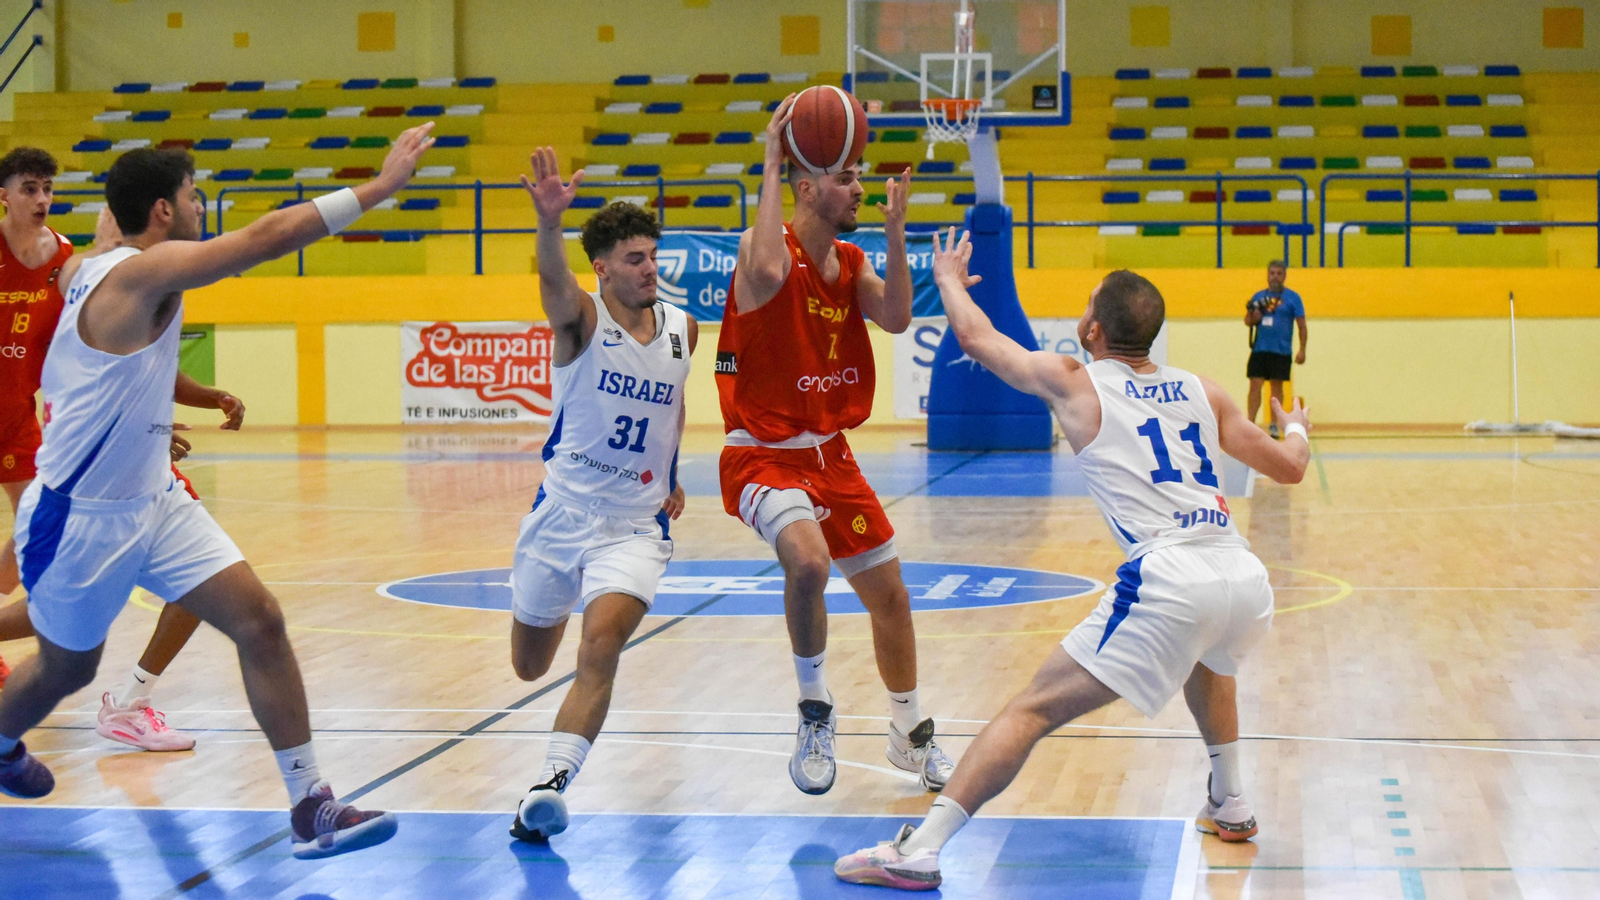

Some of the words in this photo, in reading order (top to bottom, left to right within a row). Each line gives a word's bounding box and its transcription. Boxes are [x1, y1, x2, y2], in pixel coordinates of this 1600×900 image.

[699, 249, 737, 277] Dip
[11, 312, 30, 334] 18
[412, 357, 447, 383] de
[454, 358, 496, 384] las
[499, 359, 552, 387] Ind
[715, 356, 738, 373] ank
[597, 369, 675, 406] ISRAEL
[797, 366, 859, 393] endsa
[406, 405, 423, 418] TÉ
[426, 407, 435, 418] E
[438, 407, 518, 419] INFUSIONES
[607, 415, 649, 454] 31
[1136, 417, 1219, 489] 11
